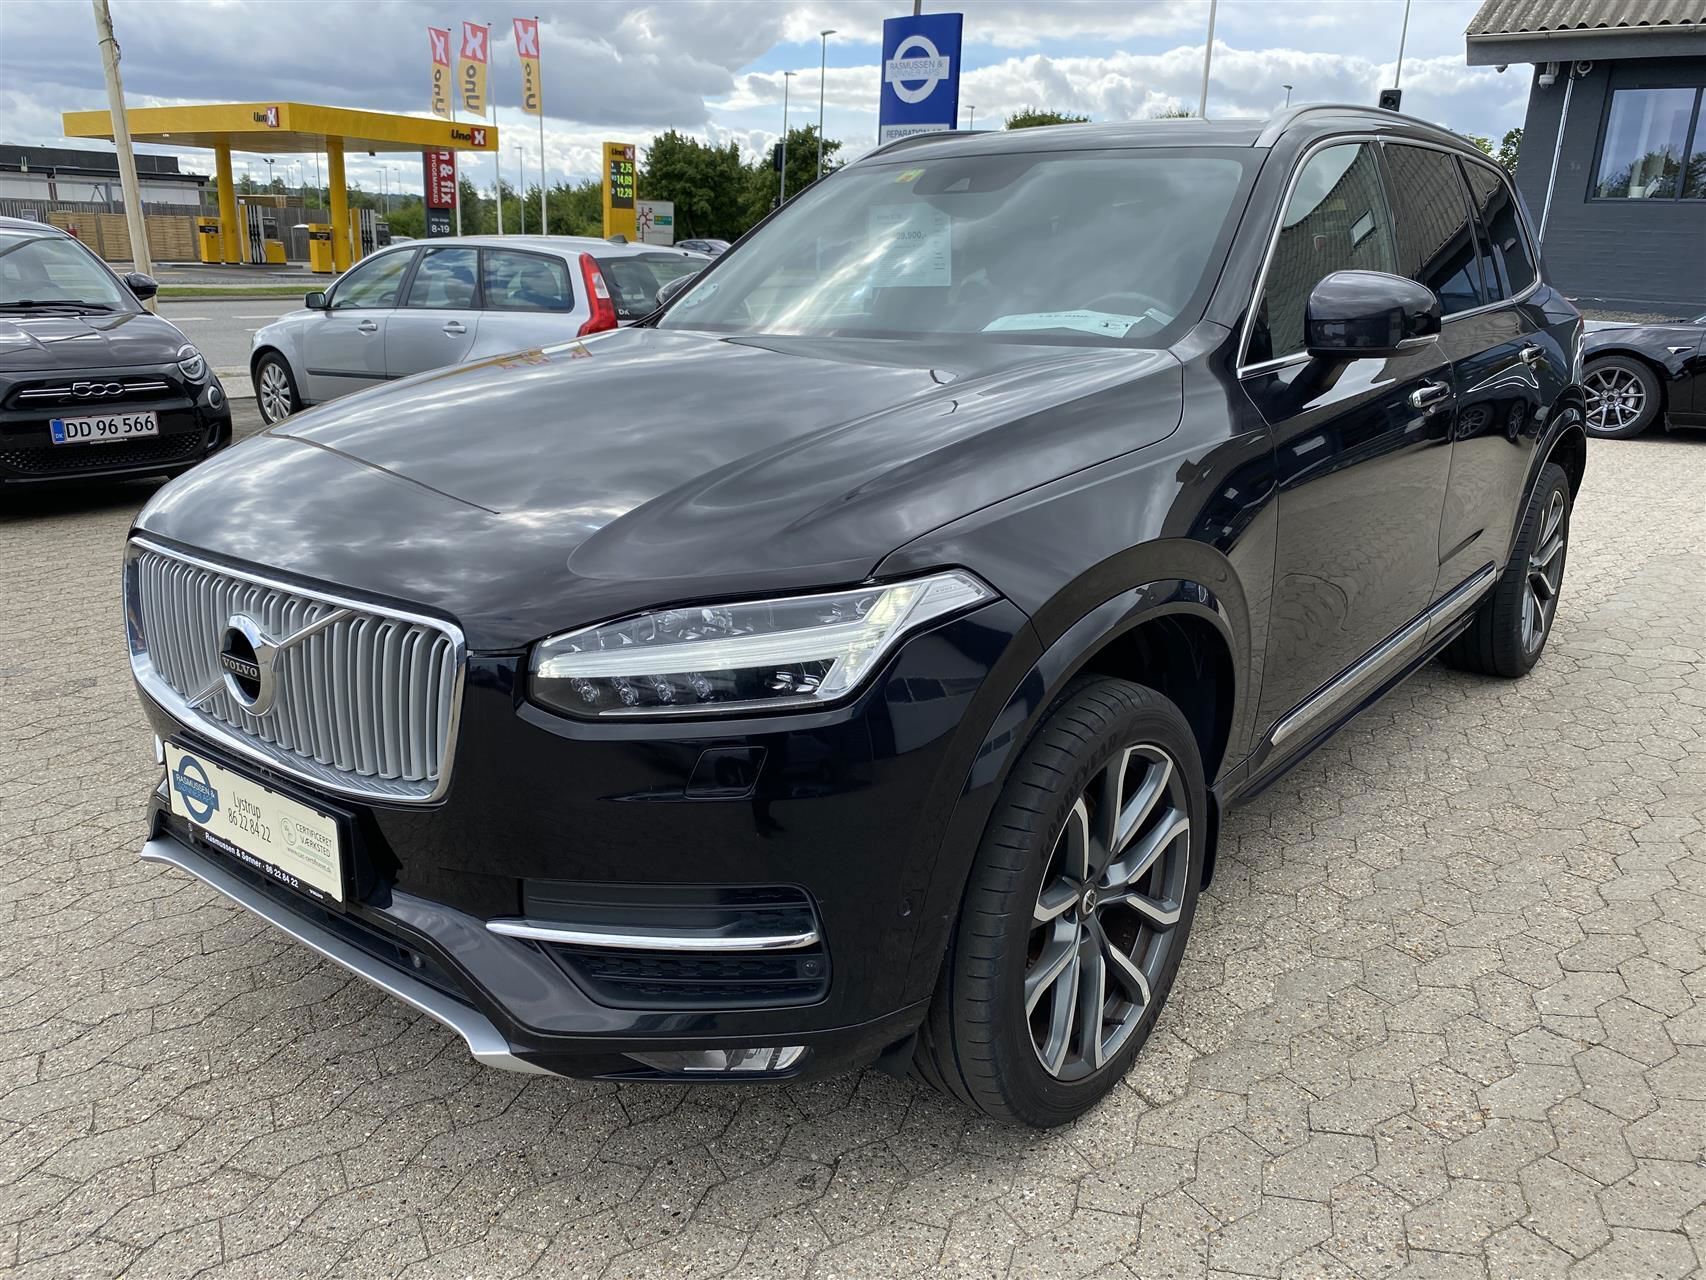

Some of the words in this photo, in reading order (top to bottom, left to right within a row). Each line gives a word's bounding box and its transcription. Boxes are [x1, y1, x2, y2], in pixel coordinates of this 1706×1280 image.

[889, 60, 935, 71] RASMUSSEN
[440, 164, 453, 177] &
[441, 181, 455, 204] fix
[432, 224, 450, 233] 8-19
[72, 382, 124, 397] 500
[66, 422, 91, 438] DD
[97, 419, 118, 435] 96
[123, 415, 154, 433] 566
[222, 656, 257, 677] VOLVO
[176, 773, 211, 796] RASMUSSEN
[233, 791, 261, 819] Lystrup
[228, 807, 237, 826] 86
[239, 813, 249, 832] 22
[250, 819, 260, 837] 84
[261, 824, 271, 843] 22
[296, 823, 332, 847] CERTIFICERET
[204, 831, 236, 857] Rasmussen
[265, 864, 274, 874] 86
[273, 868, 282, 878] 22
[290, 877, 299, 888] 22
